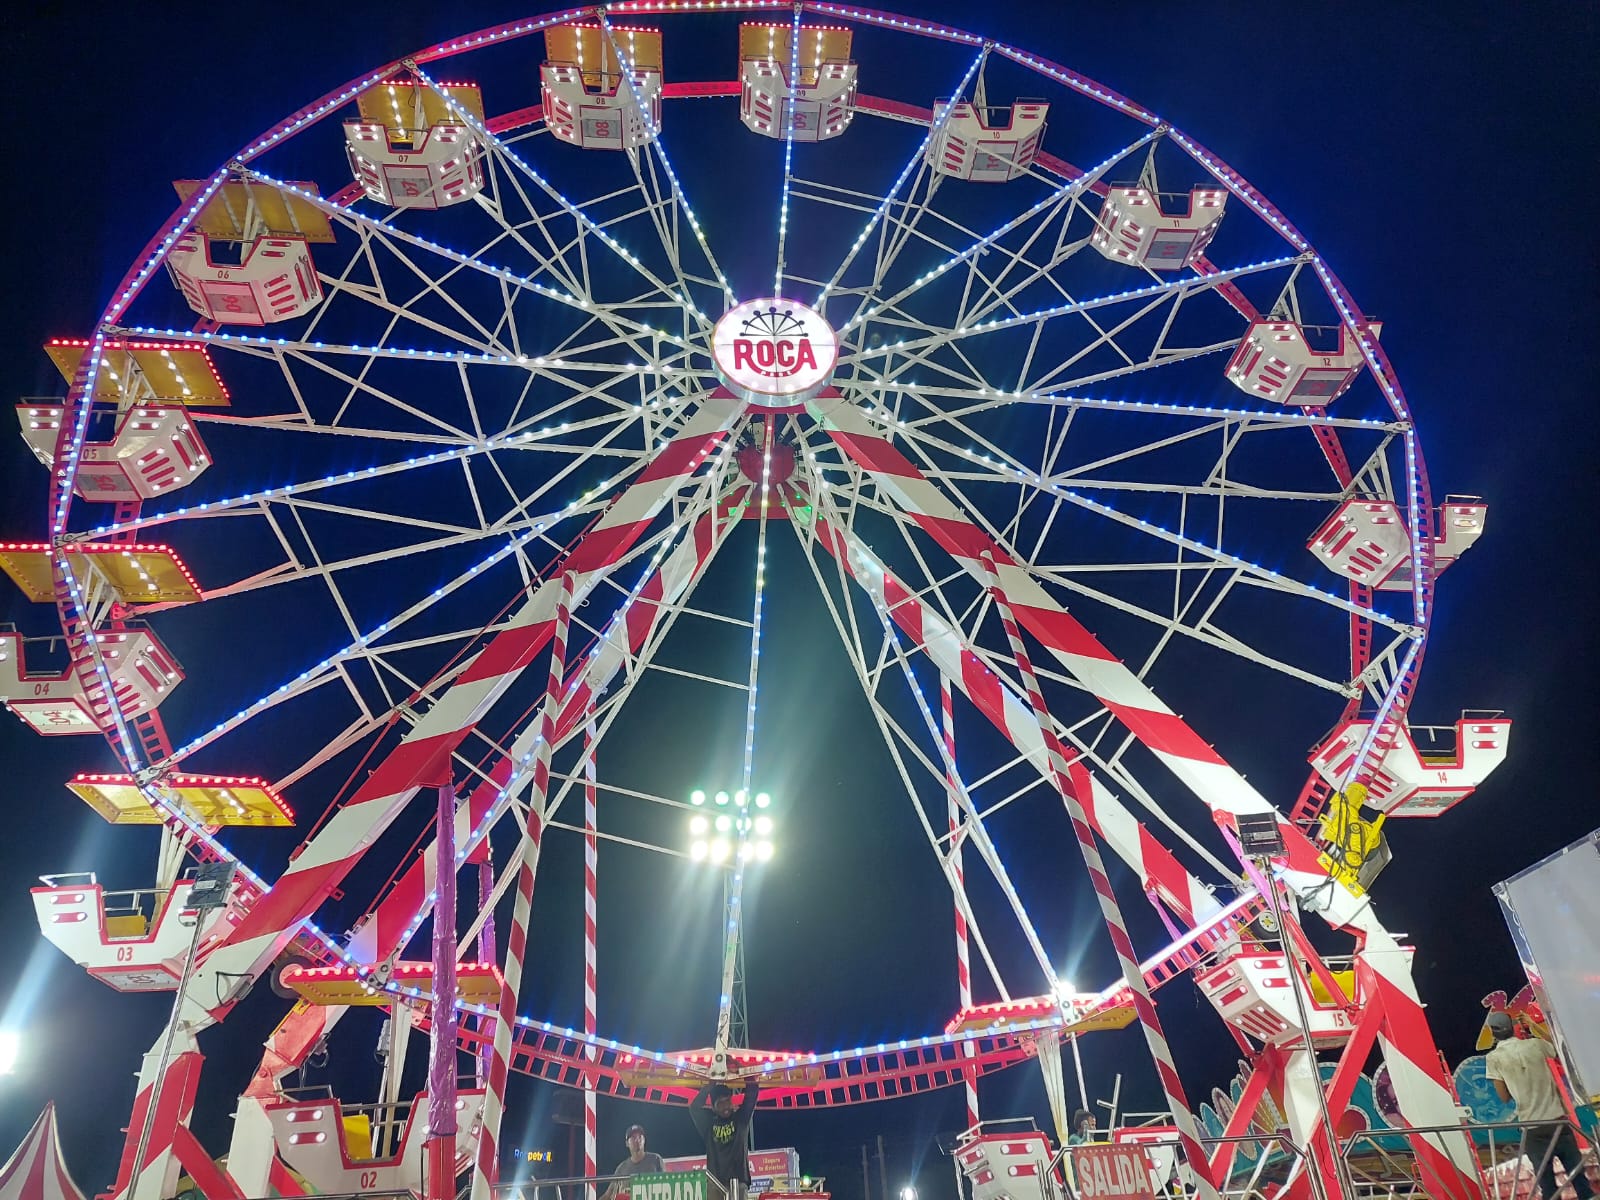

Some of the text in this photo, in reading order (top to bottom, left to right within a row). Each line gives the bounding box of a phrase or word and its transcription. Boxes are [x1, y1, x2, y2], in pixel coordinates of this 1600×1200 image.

[595, 97, 606, 105] 08
[595, 121, 609, 137] 08
[993, 131, 1001, 140] 10
[398, 154, 409, 163] 07
[1173, 219, 1180, 228] 11
[217, 270, 230, 280] 06
[222, 295, 242, 313] 06
[733, 338, 818, 377] ROCA
[1323, 357, 1332, 367] 12
[82, 448, 97, 460] 05
[34, 682, 50, 696] 04
[1437, 771, 1448, 784] 14
[116, 946, 134, 962] 03
[1332, 1012, 1345, 1028] 15
[360, 1171, 378, 1189] 02
[1079, 1153, 1150, 1197] SALIDA
[632, 1180, 704, 1200] ENTRADA
